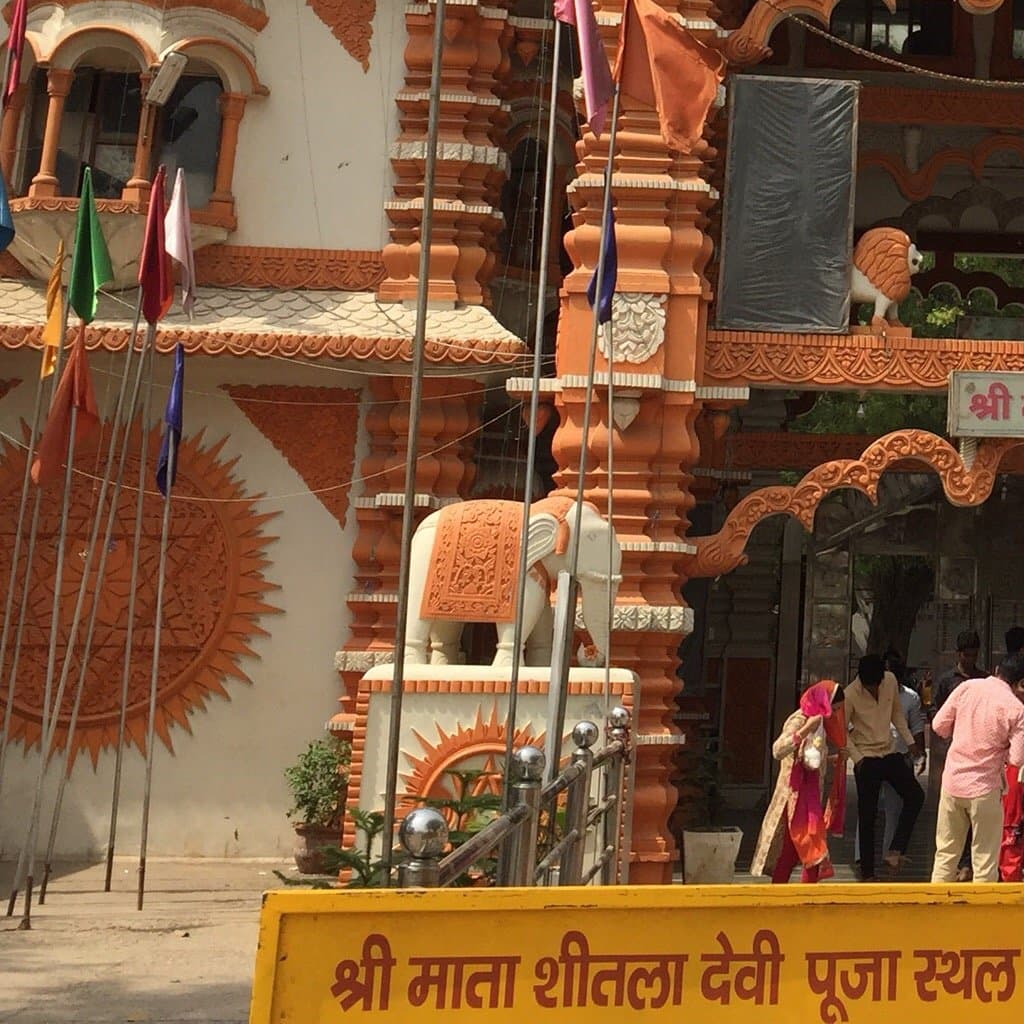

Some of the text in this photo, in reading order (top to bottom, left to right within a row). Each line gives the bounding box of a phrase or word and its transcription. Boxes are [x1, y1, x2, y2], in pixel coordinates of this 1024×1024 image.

[969, 382, 1012, 422] श्री
[330, 933, 397, 1012] श्री
[407, 956, 521, 1010] माता
[533, 930, 689, 1010] शीतला
[700, 929, 786, 1005] देवी
[805, 950, 902, 1024] पूजा
[913, 949, 1022, 1003] स्थल
